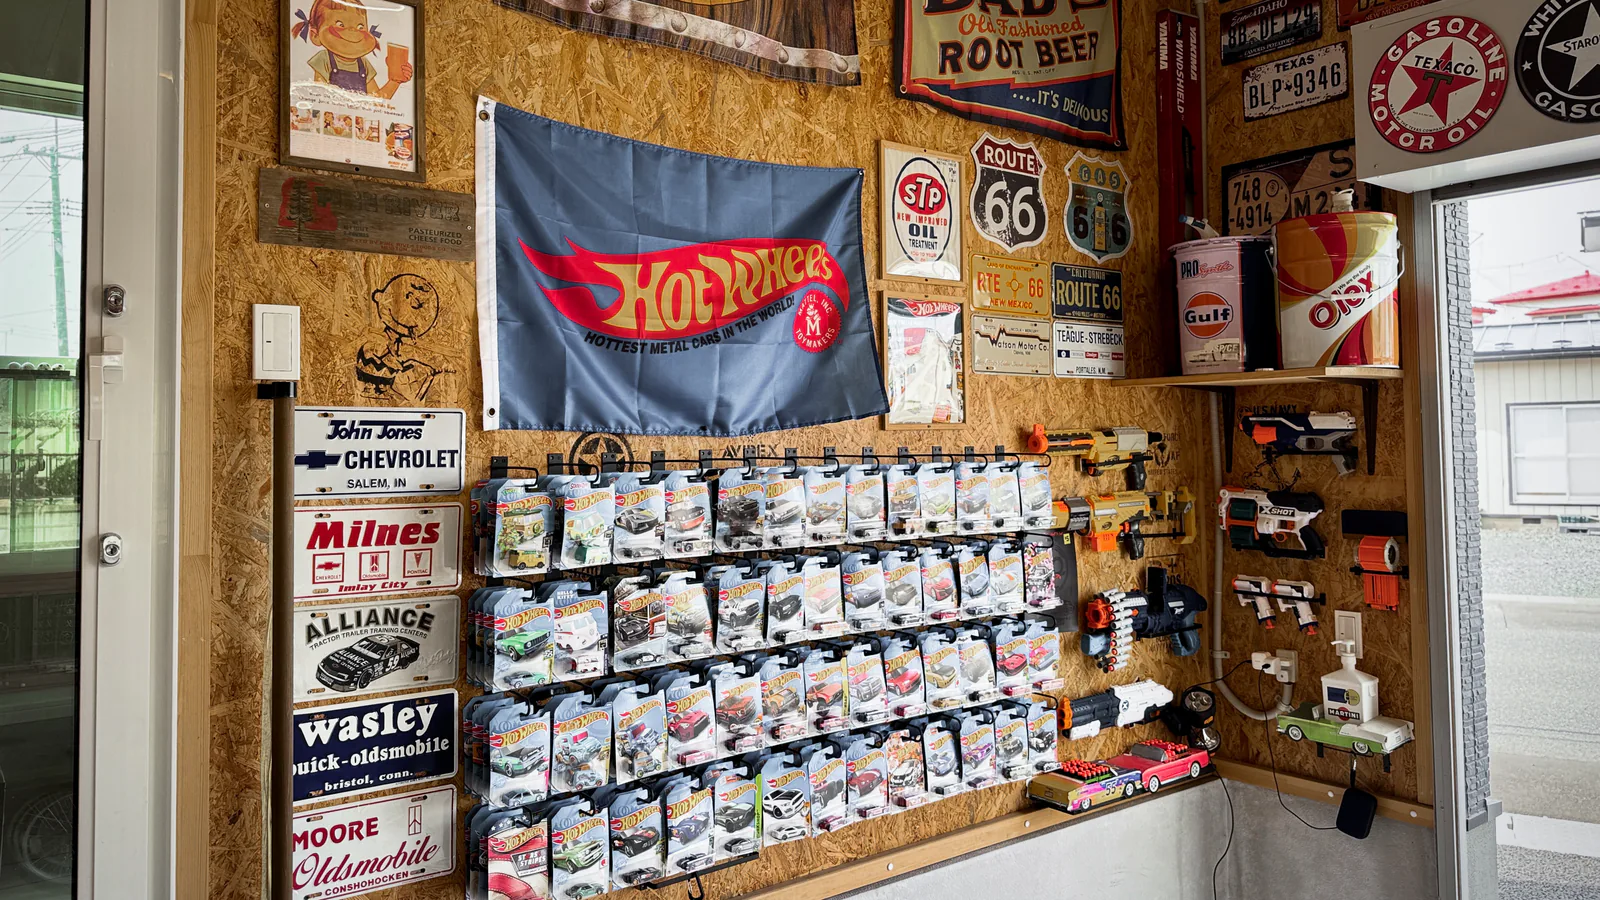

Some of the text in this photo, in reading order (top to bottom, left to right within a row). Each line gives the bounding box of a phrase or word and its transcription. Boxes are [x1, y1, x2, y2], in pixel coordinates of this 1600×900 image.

[1252, 0, 1288, 17] IDAHO
[1365, 12, 1381, 21] NEW
[1381, 3, 1409, 16] MEXICO
[958, 13, 1085, 37] Old Fashioned
[1159, 21, 1168, 70] YAKIMA
[1228, 24, 1247, 49] 8B
[1244, 36, 1295, 56] FAMOUS POTATOES
[938, 30, 1100, 75] ROOT BEER
[1190, 26, 1198, 81] YAKIMA
[1386, 17, 1505, 83] GASOLINE
[1274, 54, 1315, 74] TEXAS
[1414, 55, 1476, 76] TEXACO
[1176, 39, 1184, 114] WINDSHIELD
[1249, 62, 1341, 110] BLP 9346
[1423, 72, 1453, 104] T
[1371, 83, 1493, 150] MOTOR OIL
[984, 144, 1034, 173] ROUTE
[1082, 167, 1118, 187] GAS
[904, 177, 942, 210] STP
[1234, 177, 1260, 206] 748
[984, 180, 1037, 236] 66
[897, 212, 948, 227] NEW IMPROVED
[408, 227, 462, 239] PASTEURIZED
[408, 234, 438, 244] CHEESE
[440, 238, 462, 246] FOOD
[908, 223, 938, 239] OIL
[908, 238, 938, 250] TREATMENT
[1072, 268, 1106, 280] CALIFORNIA
[1181, 260, 1199, 279] PRO
[1338, 282, 1346, 290] We
[1359, 265, 1371, 275] family
[977, 272, 1044, 298] RTE 66
[1056, 279, 1121, 311] ROUTE 66
[990, 298, 1033, 310] NEW MEXICO
[584, 294, 796, 354] HOTTEST METAL CARS IN THE WORLD!
[1185, 308, 1230, 324] Gulf
[796, 326, 836, 349] TOYMAKERS
[806, 319, 822, 336] M
[1018, 340, 1037, 350] Motor
[1038, 343, 1049, 352] Co.
[1076, 366, 1096, 375] PORTALES,
[326, 420, 426, 440] John Jones
[344, 450, 459, 470] CHEVROLET
[347, 478, 407, 490] SALEM, IN
[306, 520, 441, 550] Milnes
[338, 581, 408, 593] Imlay City
[506, 608, 548, 630] HOT WHEELS
[561, 601, 602, 618] HOT WHEELS
[305, 607, 436, 645] ALLIANCE
[309, 627, 428, 651] TRACTOR TRAILER TRAINING CENTERS
[338, 650, 369, 666] ALLIANCE
[385, 656, 400, 672] 59
[1329, 709, 1360, 719] MARTINI
[299, 703, 438, 748] wasley
[502, 723, 546, 746] HOT WHEELS
[324, 776, 374, 792] bristol,
[378, 769, 414, 782] conn.
[672, 803, 688, 819] HOT
[293, 817, 379, 851] MOORE
[564, 819, 603, 842] HOT WHEELS
[622, 817, 636, 830] HOT
[506, 829, 544, 850] HOT WHEELS
[293, 836, 441, 891] Oldsmobile
[325, 870, 409, 896] CONSHOHOCKEN
